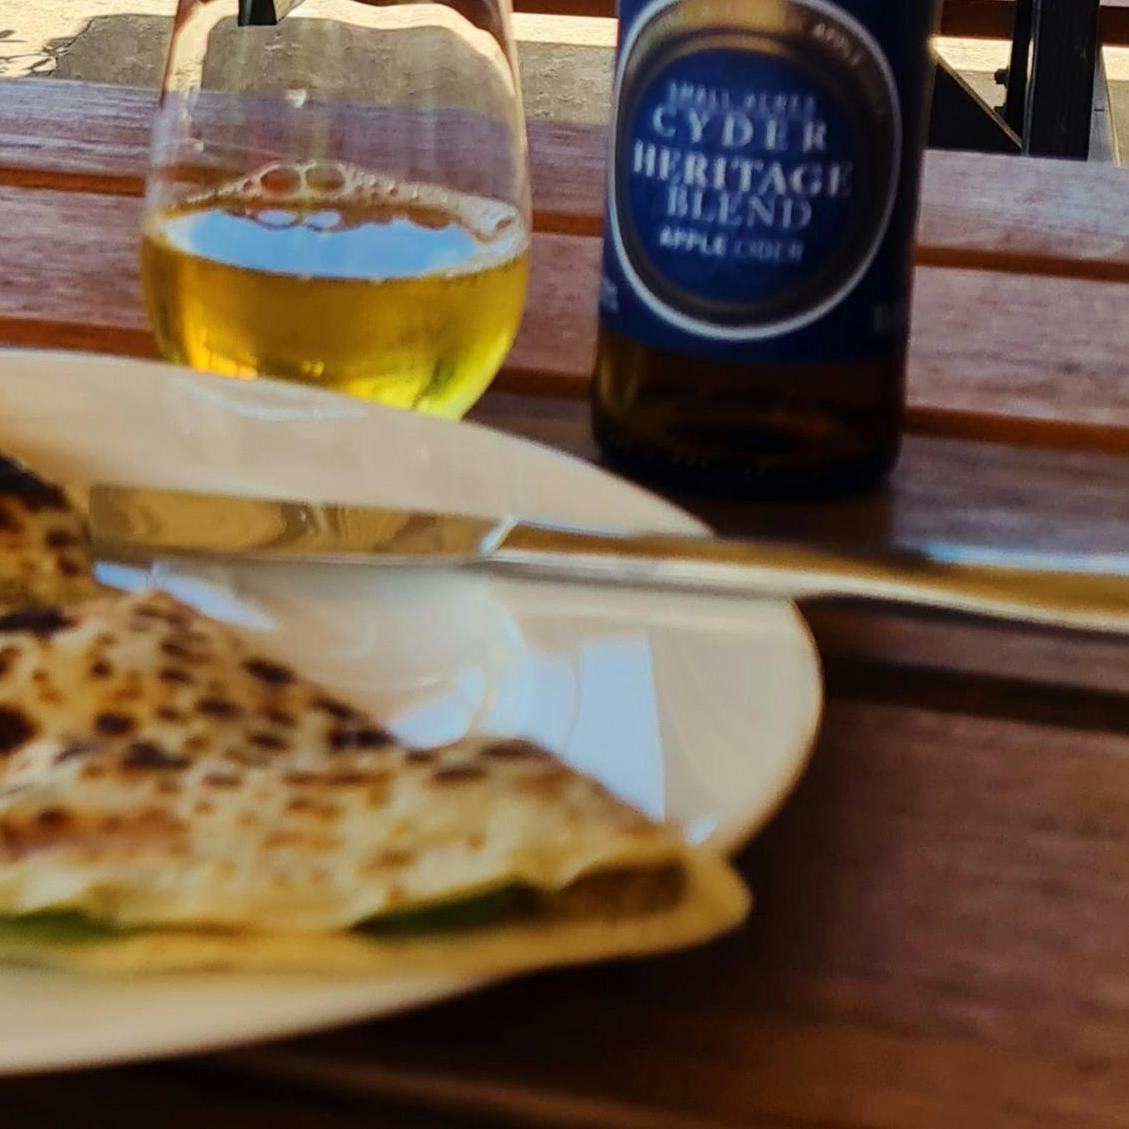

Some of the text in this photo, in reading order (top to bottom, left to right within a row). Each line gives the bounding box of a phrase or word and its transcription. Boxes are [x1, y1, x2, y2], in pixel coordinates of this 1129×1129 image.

[652, 104, 828, 152] CYDER
[632, 138, 854, 197] HERITAGE
[666, 184, 813, 231] BLEND
[658, 225, 728, 257] APPLE
